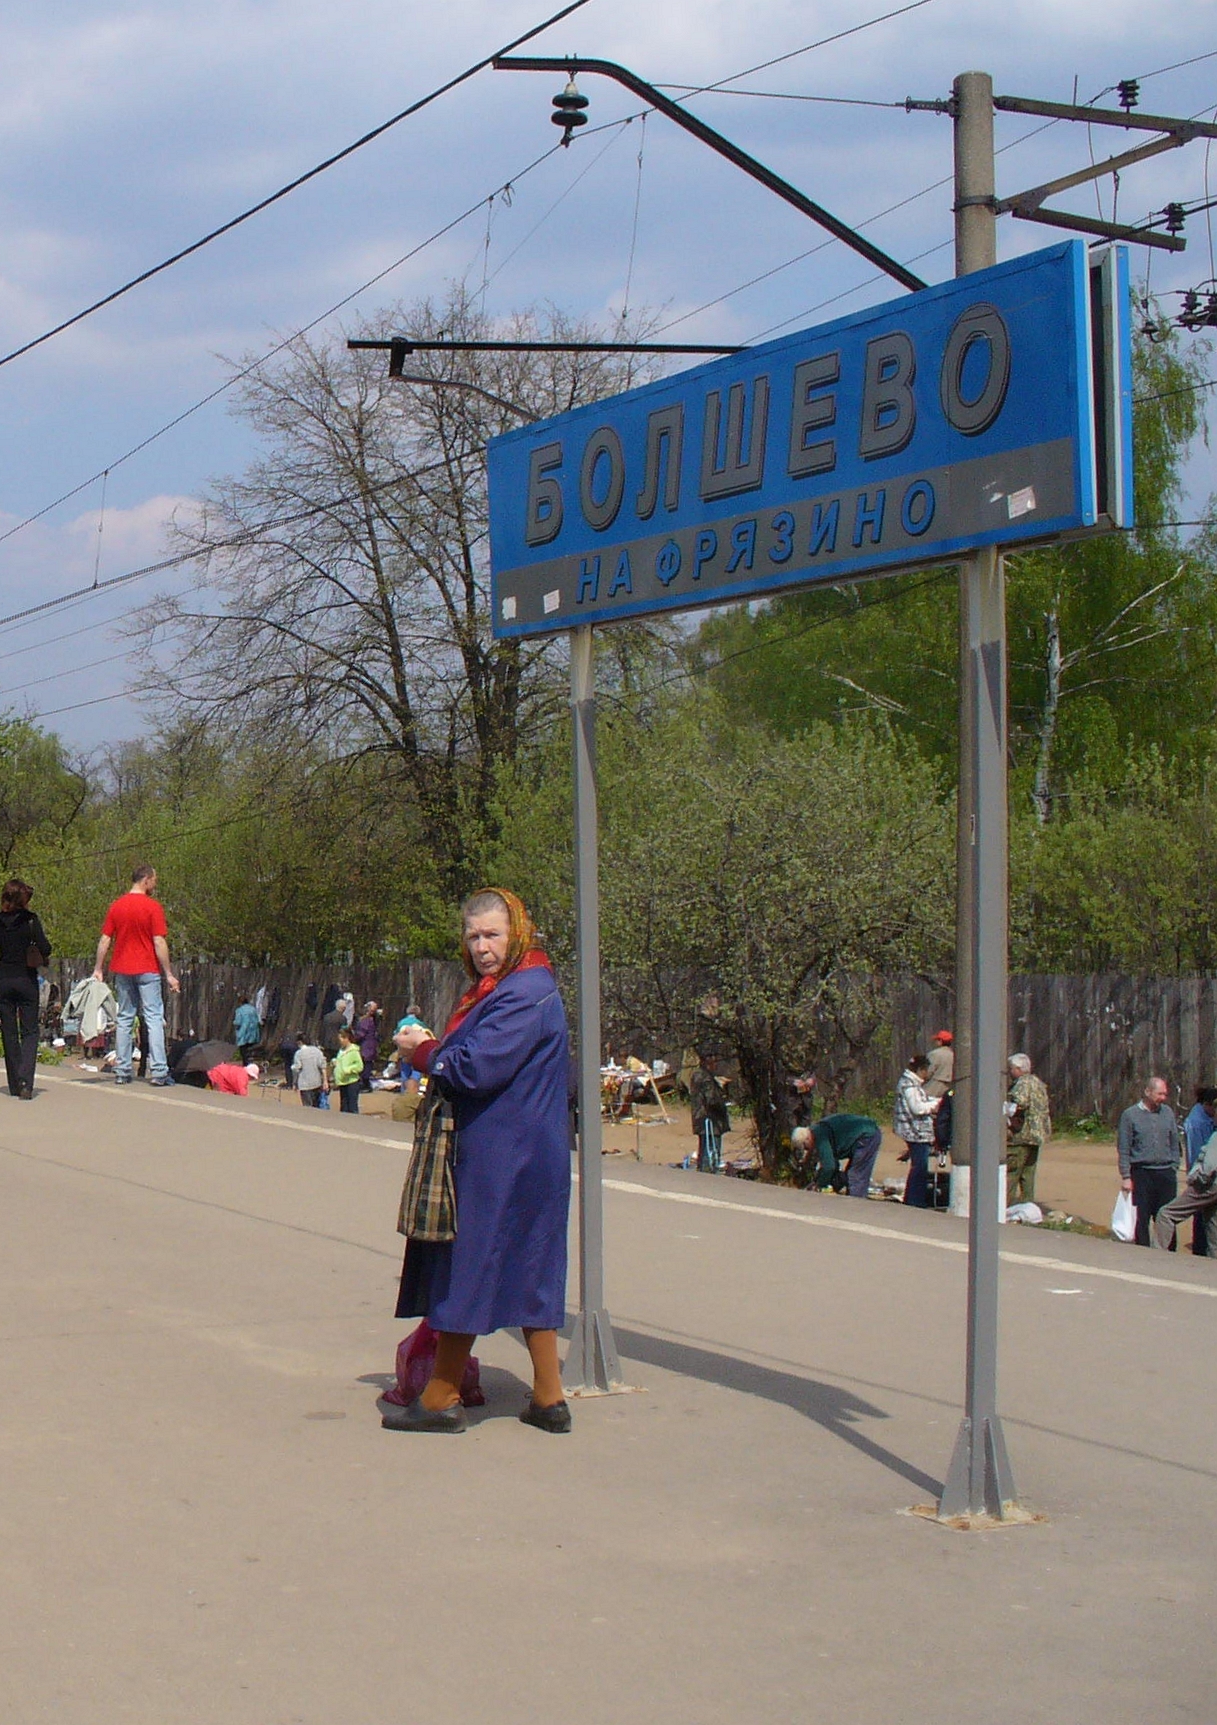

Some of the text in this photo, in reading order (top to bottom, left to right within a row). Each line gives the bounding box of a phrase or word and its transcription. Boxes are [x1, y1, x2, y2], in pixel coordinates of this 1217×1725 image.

[525, 303, 1011, 546] БОЛШЕВО
[576, 480, 936, 605] НА ФРЯЗИНО
